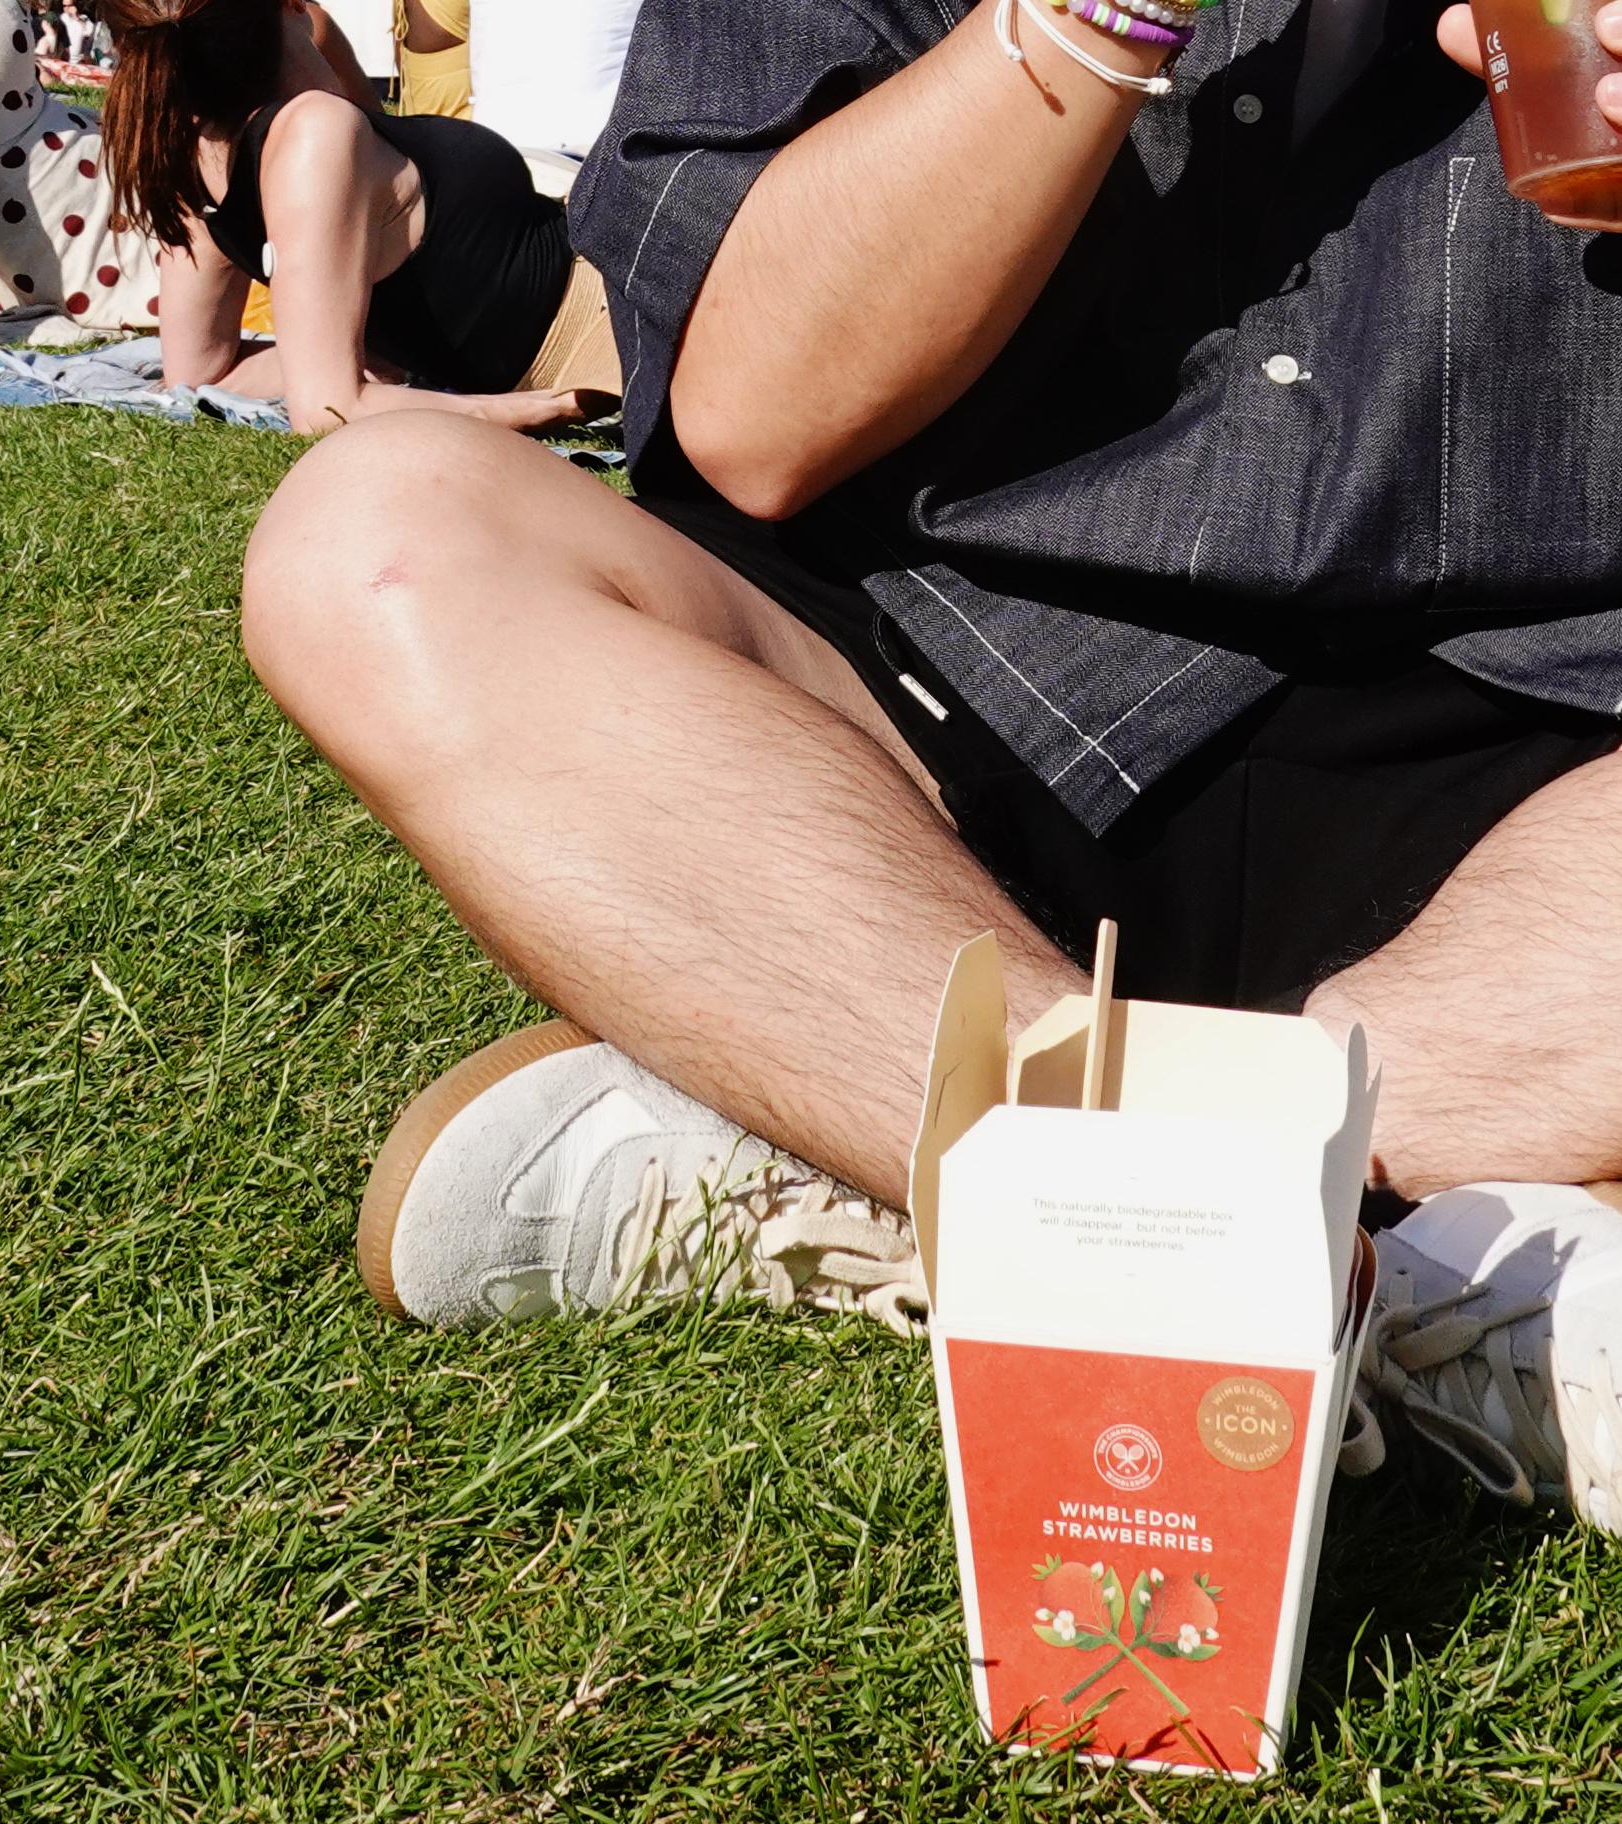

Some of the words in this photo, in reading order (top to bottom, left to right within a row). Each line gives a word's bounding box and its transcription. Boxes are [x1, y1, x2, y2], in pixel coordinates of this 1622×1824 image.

[1033, 1197, 1057, 1210] This
[1060, 1200, 1114, 1215] naturally
[1117, 1205, 1207, 1219] biodegradable
[1210, 1209, 1233, 1222] box
[1039, 1216, 1060, 1226] will
[1136, 1222, 1157, 1234] but
[1161, 1223, 1181, 1235] not
[1185, 1225, 1227, 1238] before
[1076, 1234, 1103, 1246] your
[1211, 1383, 1280, 1411] WIMBLEDON
[1235, 1403, 1257, 1416] THE
[1215, 1414, 1277, 1436] ICON
[1213, 1436, 1280, 1464] WIMBLEDON
[1105, 1470, 1152, 1488] WIMBLEDON
[1058, 1500, 1197, 1531] WIMBLEDON
[1042, 1519, 1214, 1554] STRAWBERRIES
